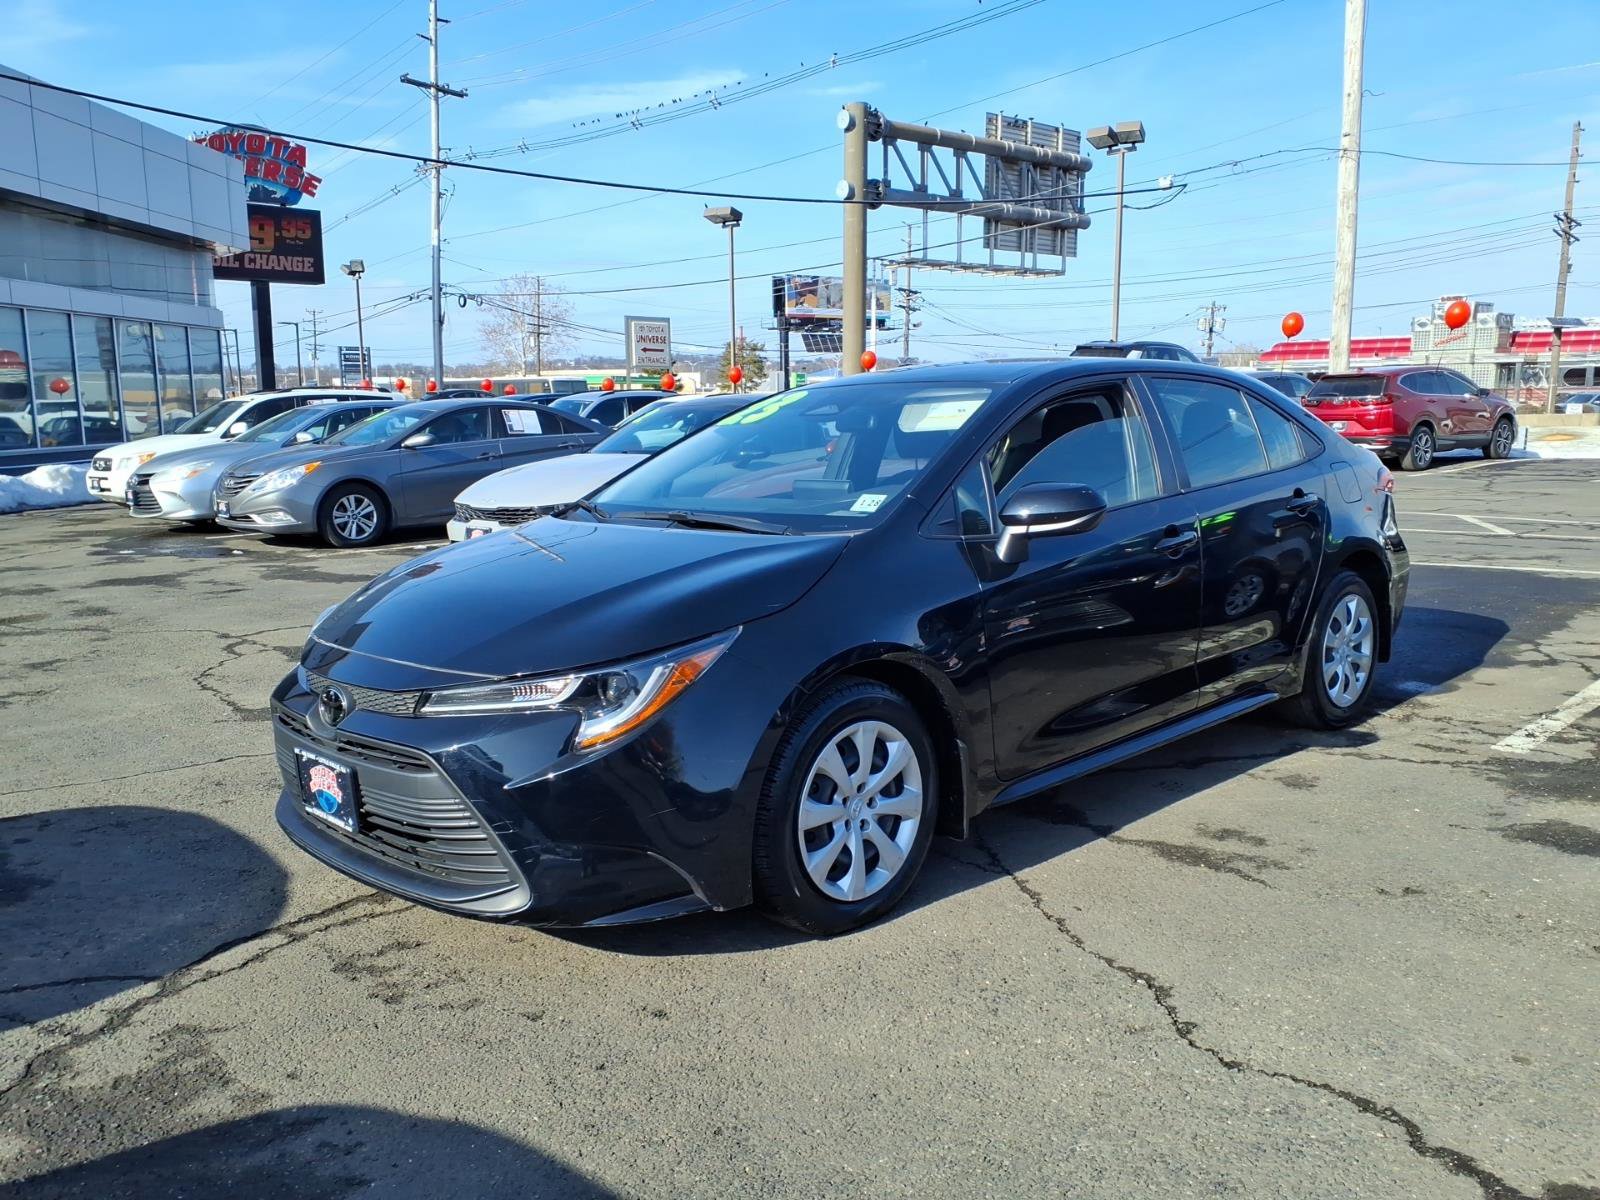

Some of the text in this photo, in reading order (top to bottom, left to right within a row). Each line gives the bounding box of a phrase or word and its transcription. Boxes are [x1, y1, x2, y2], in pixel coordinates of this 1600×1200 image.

[244, 253, 314, 273] CHANGE
[635, 334, 667, 345] UNIVERSE
[637, 356, 667, 365] ENTRANCE
